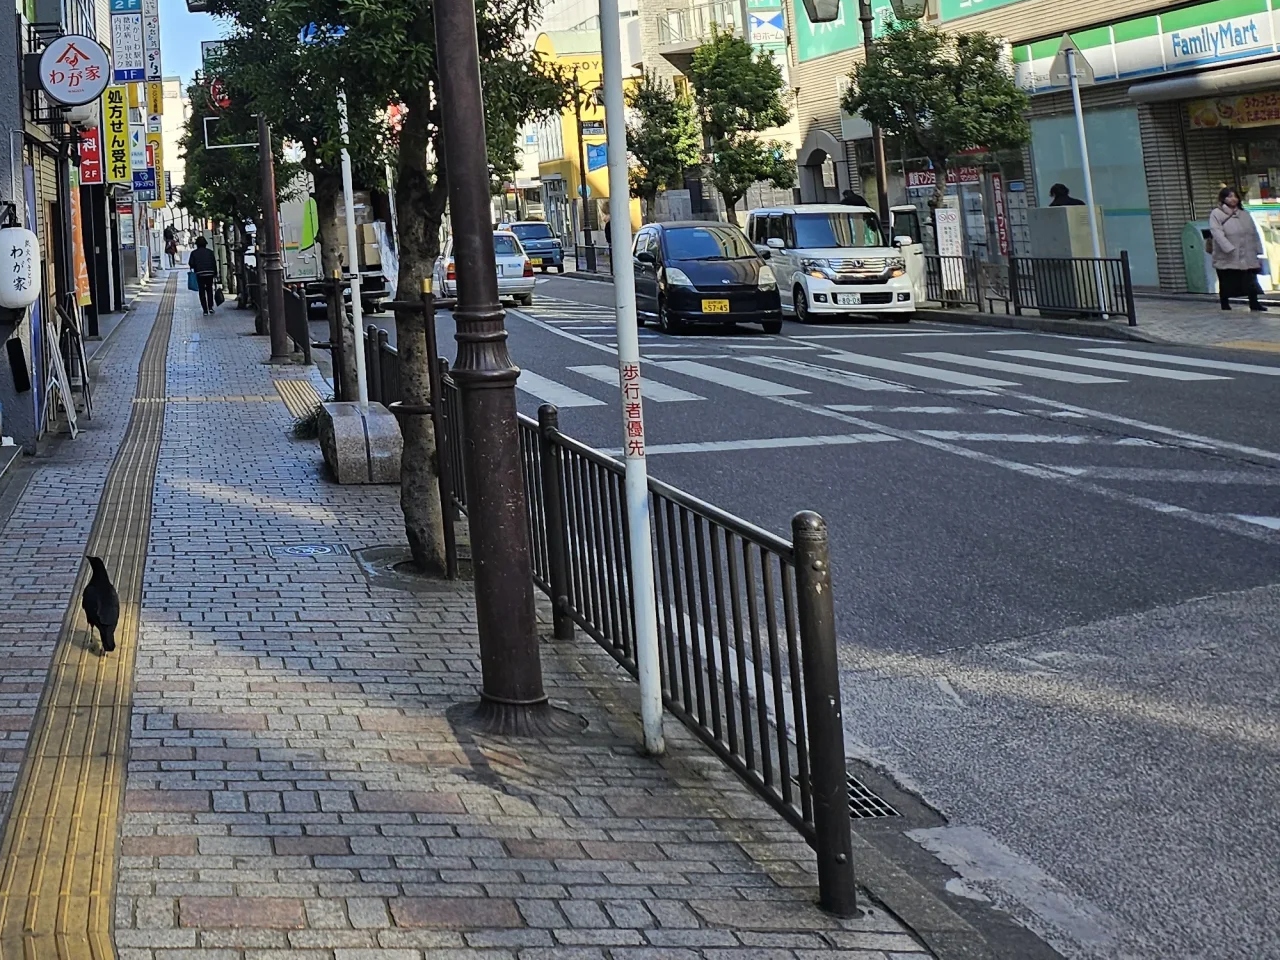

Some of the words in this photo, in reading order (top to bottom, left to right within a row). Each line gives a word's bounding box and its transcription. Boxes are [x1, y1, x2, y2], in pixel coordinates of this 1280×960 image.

[115, 0, 136, 9] 2F
[1171, 18, 1259, 58] FamilyMart
[49, 65, 101, 88] わが家
[123, 70, 138, 79] 1F
[107, 90, 127, 179] 処方せん受付
[84, 170, 98, 178] 2F
[10, 245, 28, 291] わが家
[623, 364, 645, 457] 歩行者優先
